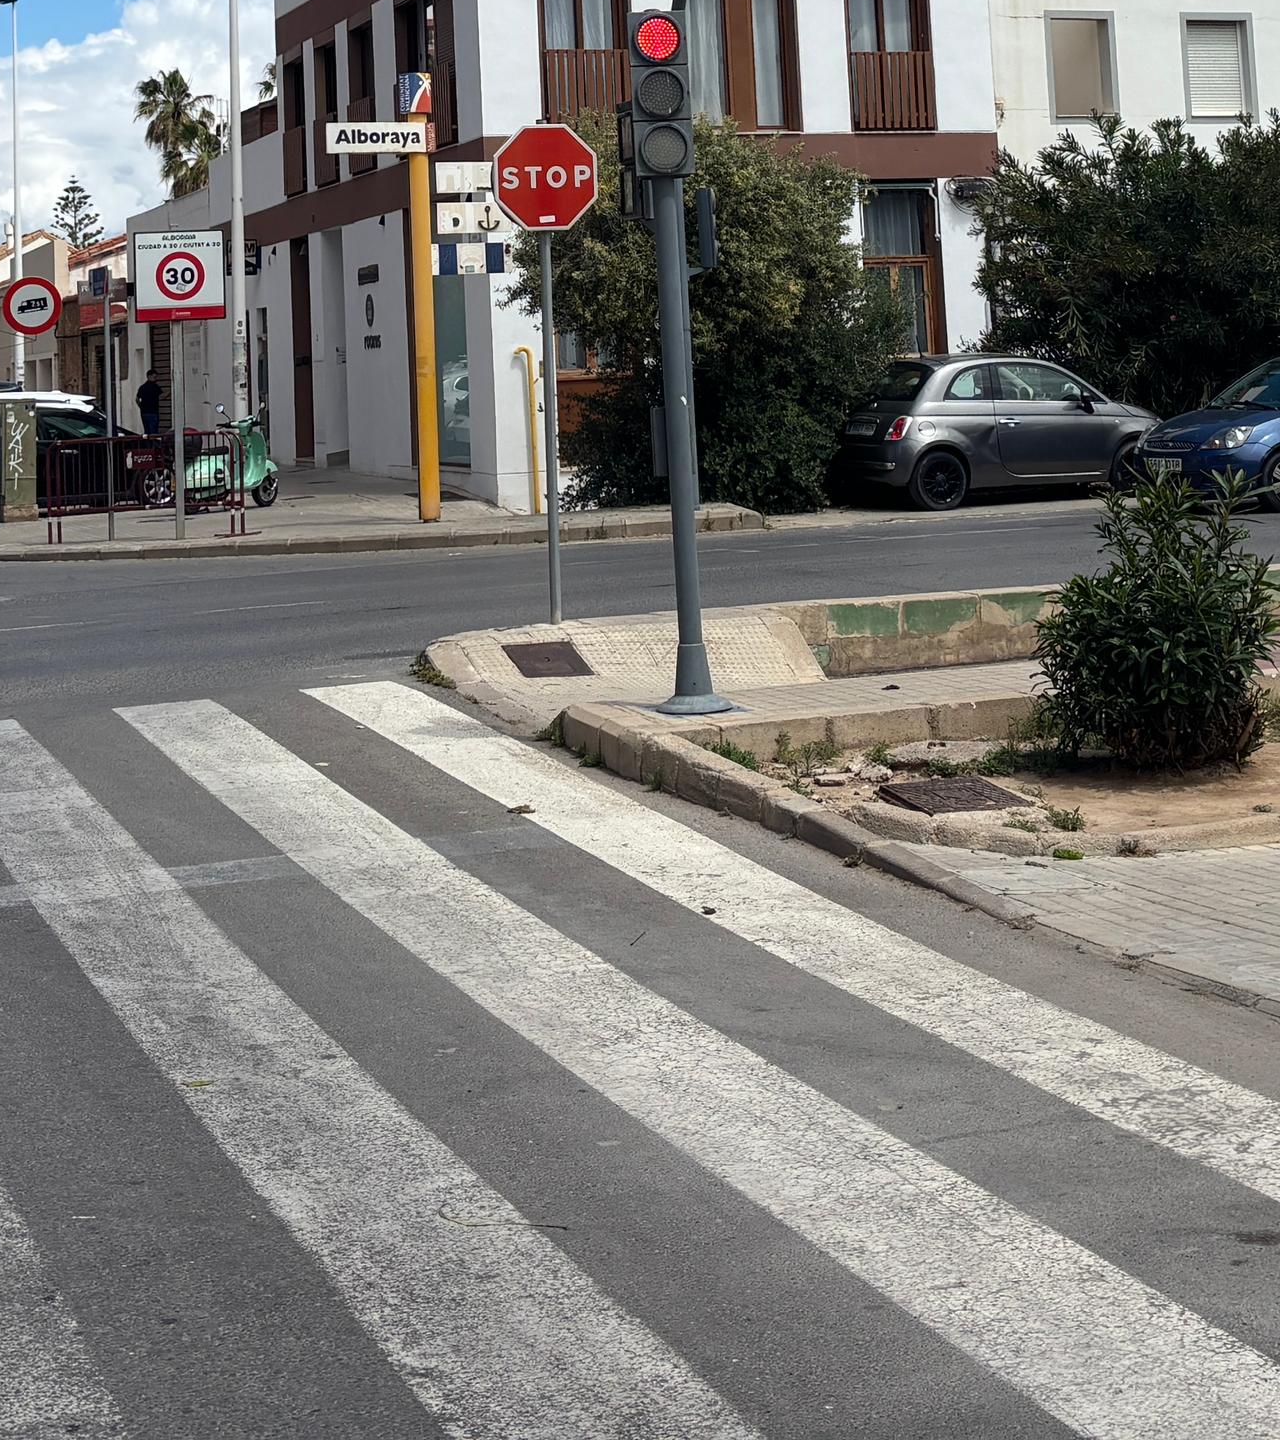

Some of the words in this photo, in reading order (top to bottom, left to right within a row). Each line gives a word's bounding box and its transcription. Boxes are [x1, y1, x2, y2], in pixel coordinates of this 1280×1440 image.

[335, 129, 421, 148] Alboraya
[501, 165, 592, 190] STOP
[165, 267, 196, 286] 30
